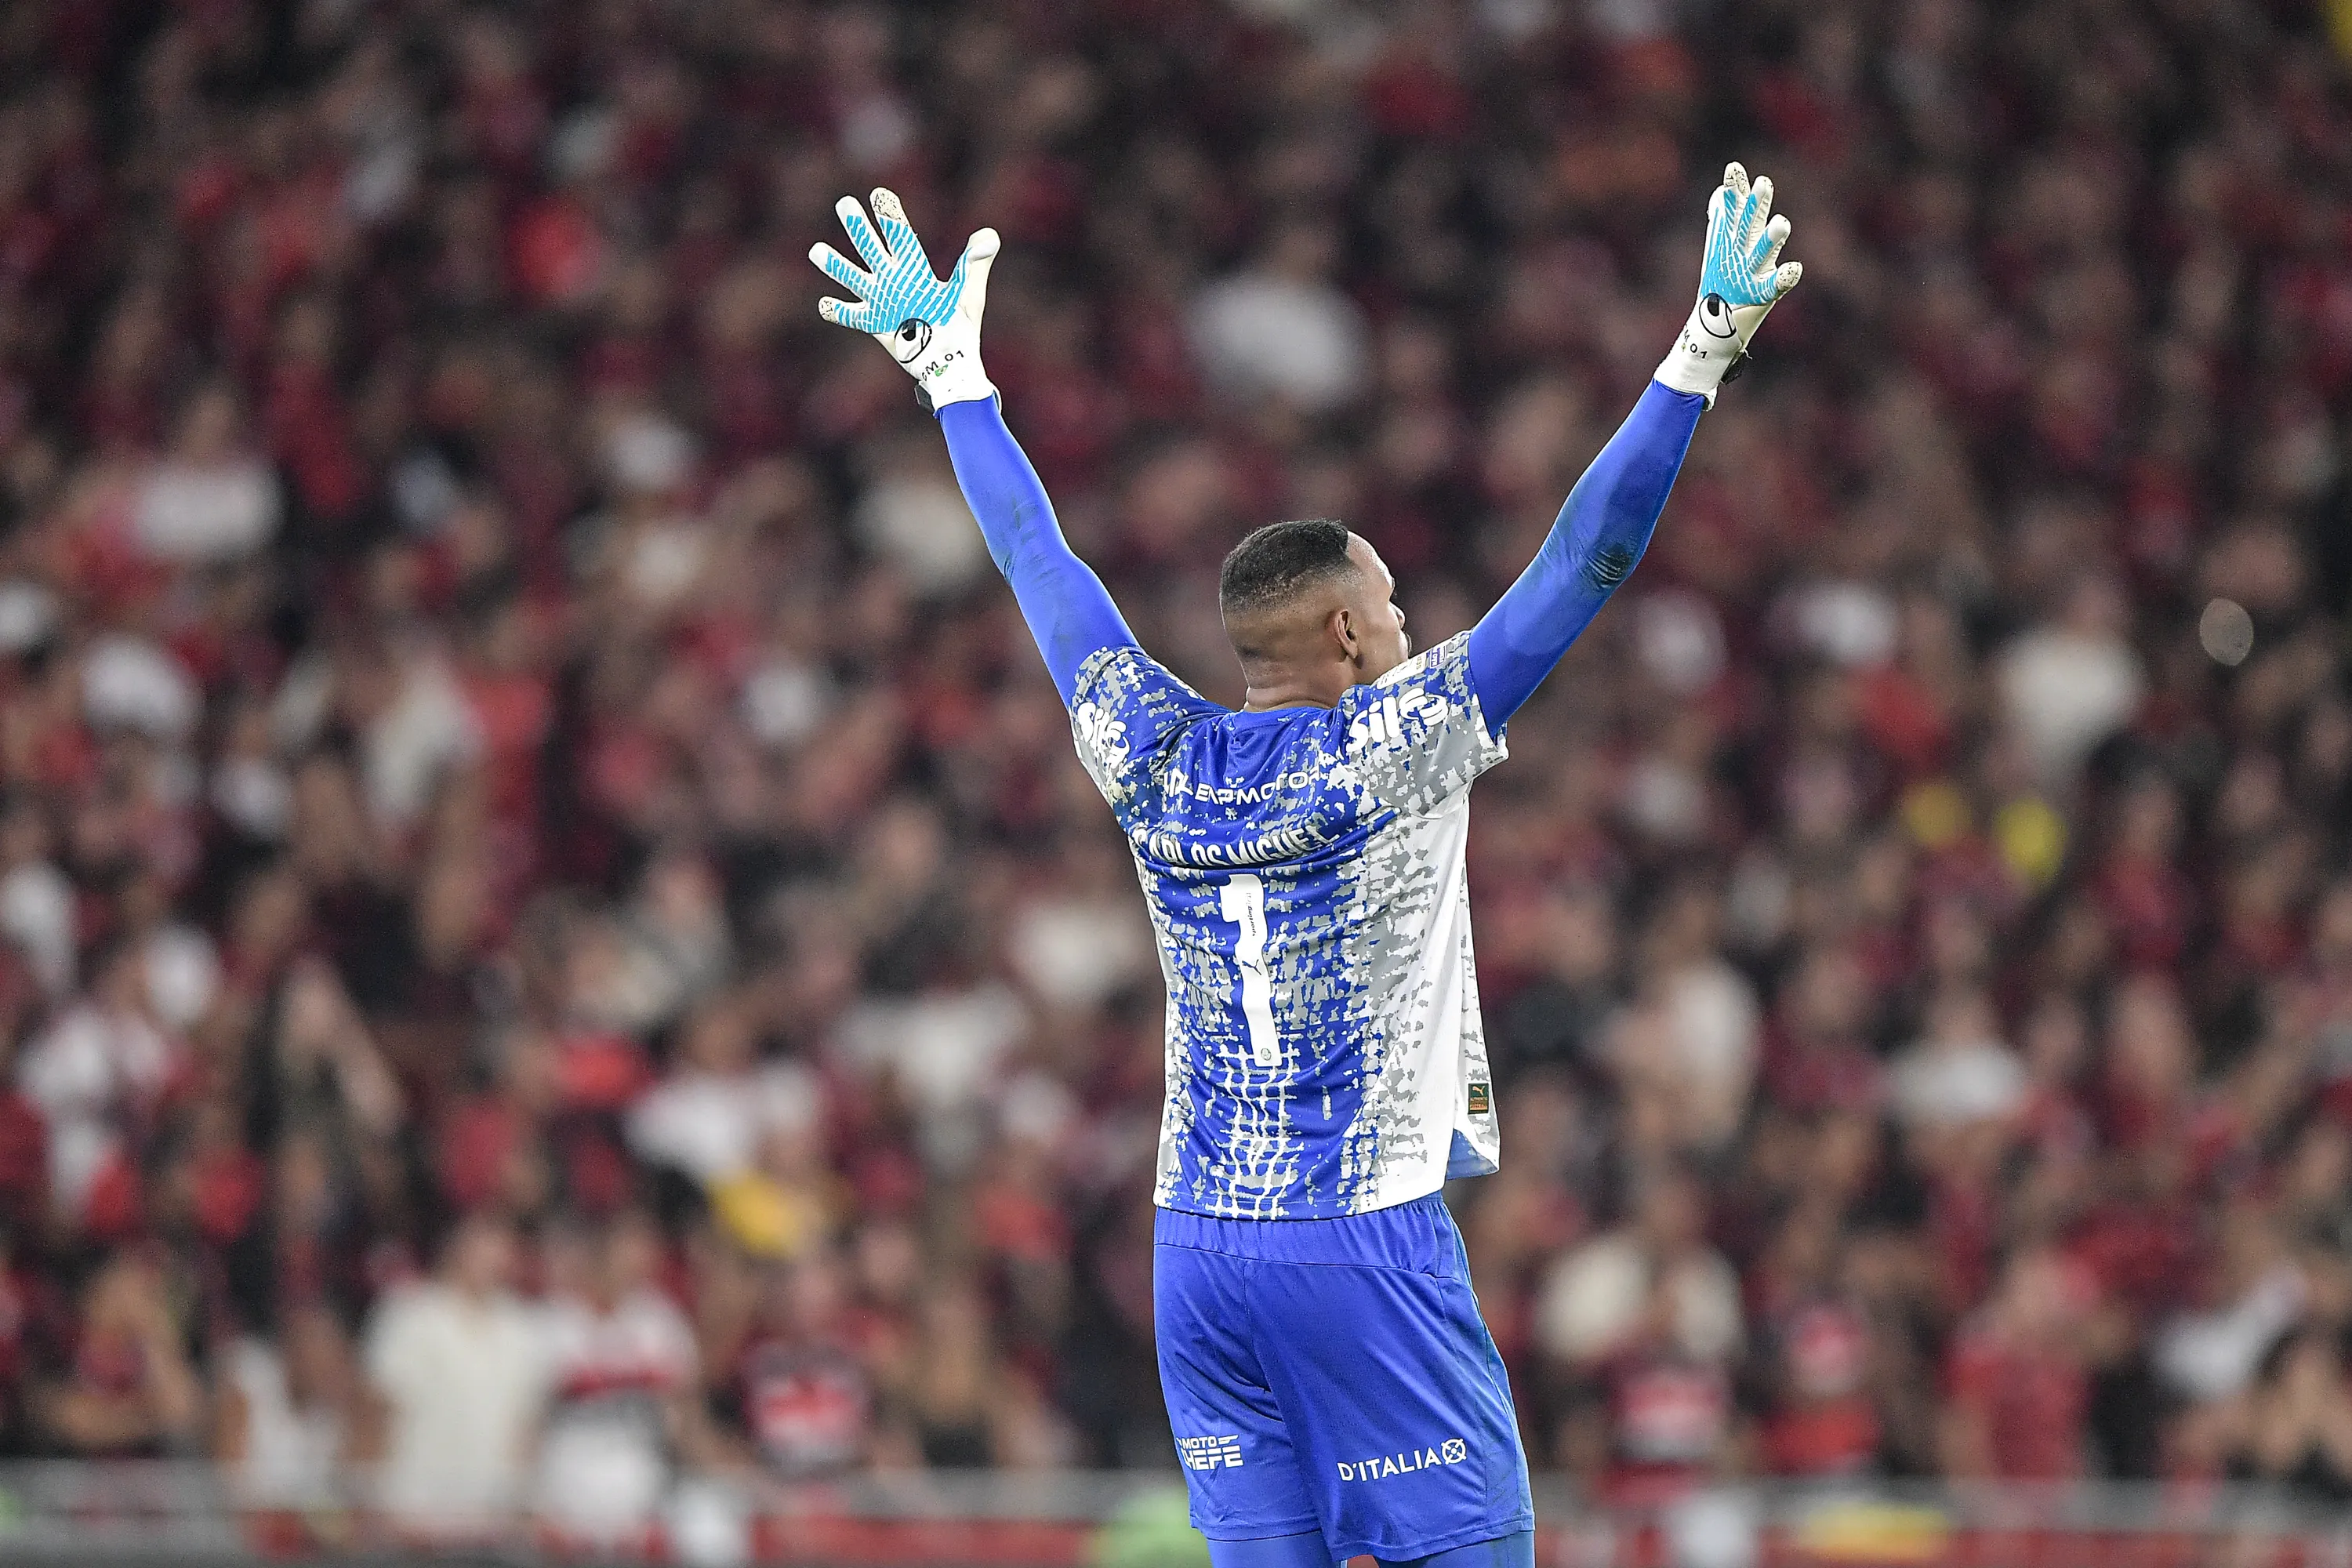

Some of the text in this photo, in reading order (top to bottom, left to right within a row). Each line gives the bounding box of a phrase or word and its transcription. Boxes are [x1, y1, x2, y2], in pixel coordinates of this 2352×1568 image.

[944, 350, 965, 362] 01
[1689, 343, 1708, 359] 01
[1218, 873, 1283, 1068] 1
[1181, 1436, 1218, 1450] MOTO
[1337, 1446, 1443, 1482] D'ITALIA
